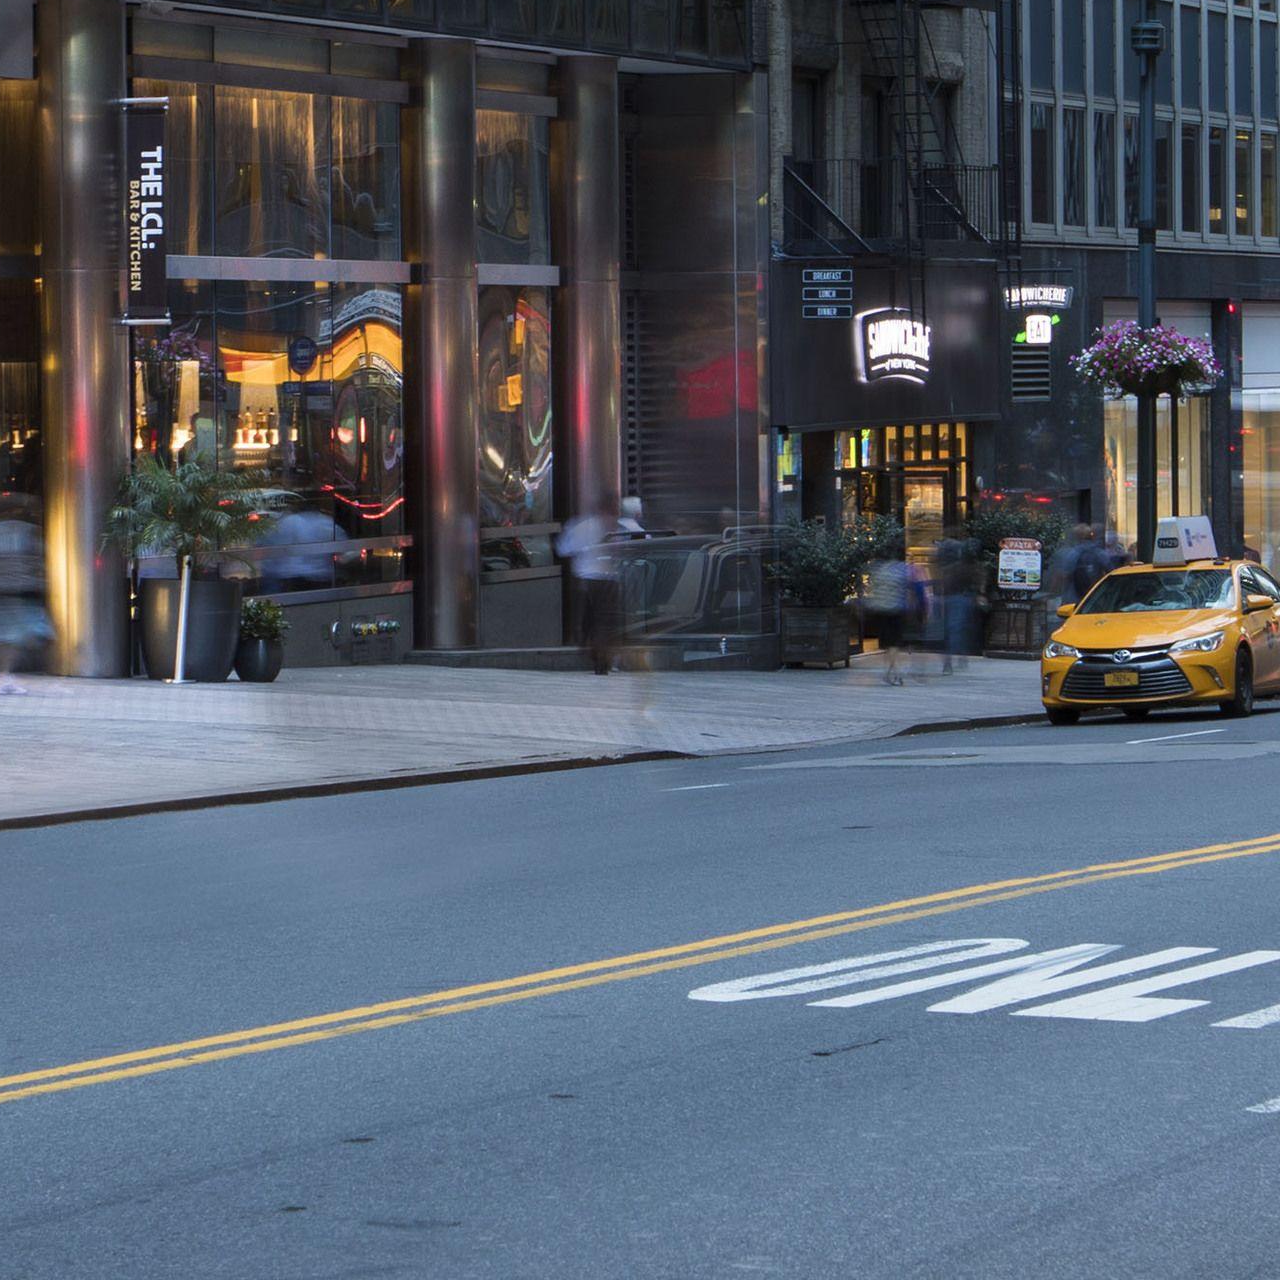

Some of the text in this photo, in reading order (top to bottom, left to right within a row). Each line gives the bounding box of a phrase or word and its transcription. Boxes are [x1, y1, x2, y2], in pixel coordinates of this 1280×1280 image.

[141, 146, 163, 197] THE
[129, 180, 142, 291] BAR & KITCHEN
